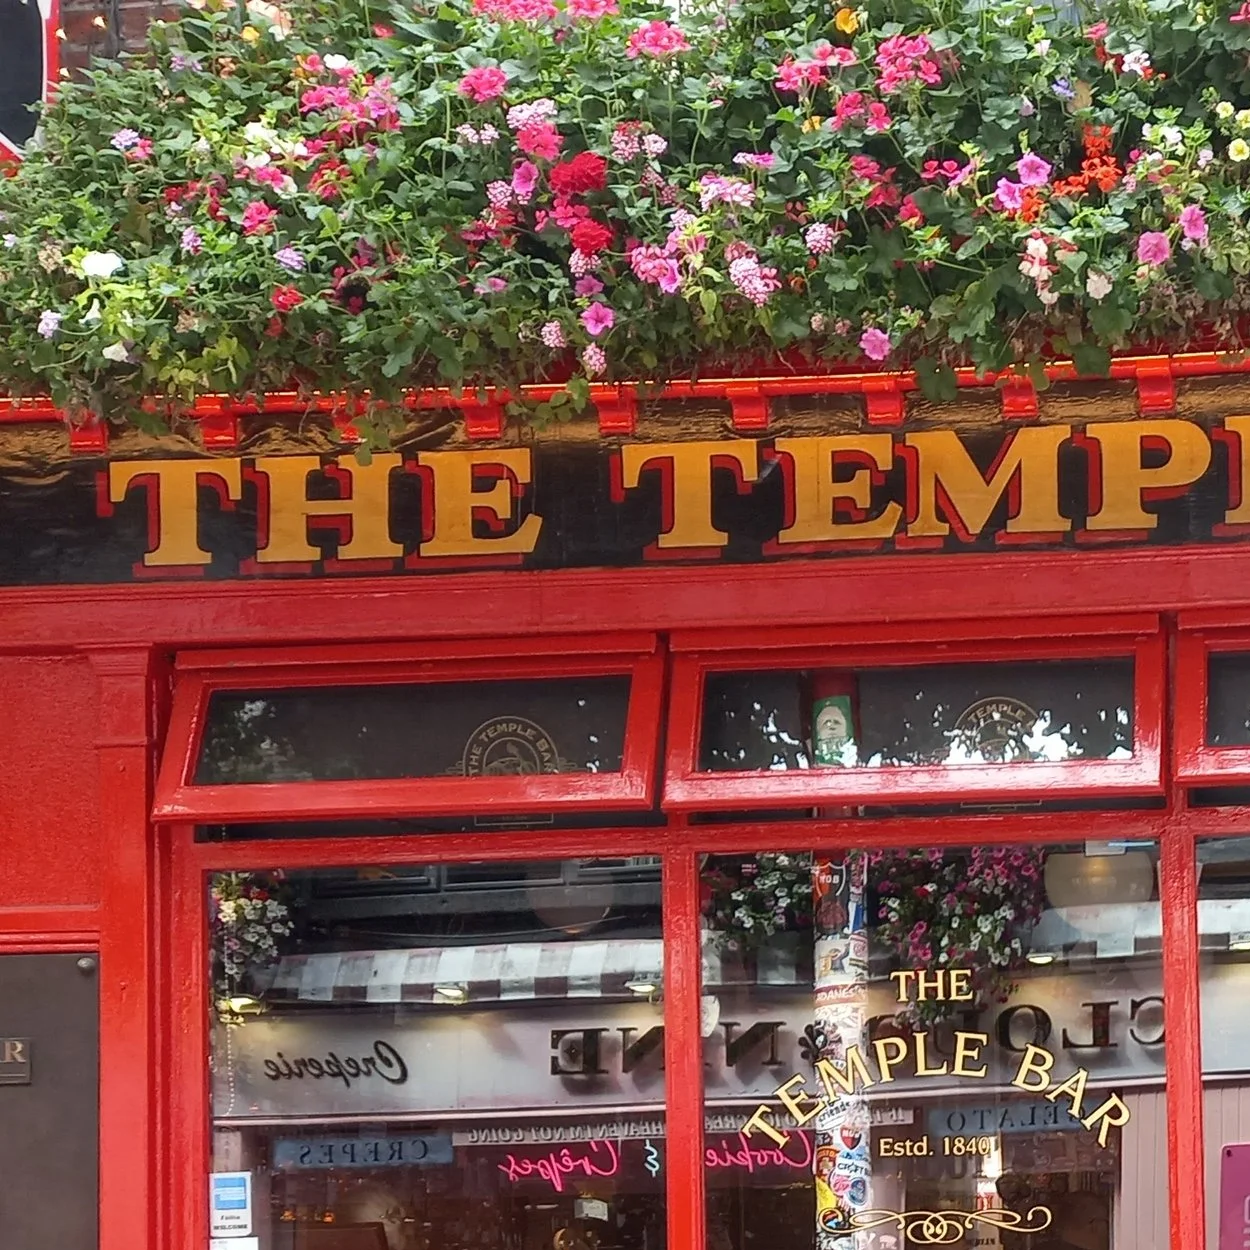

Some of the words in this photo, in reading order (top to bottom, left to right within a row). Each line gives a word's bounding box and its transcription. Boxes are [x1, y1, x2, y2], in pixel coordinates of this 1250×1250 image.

[98, 445, 543, 576] THE
[967, 703, 1027, 725] TEMPLE
[468, 744, 483, 775] THE
[479, 723, 537, 742] TEMPLE
[890, 968, 973, 1003] THE
[742, 1031, 989, 1150] TEMPLE
[1011, 1043, 1131, 1148] BAR
[879, 1137, 935, 1157] Estd.
[943, 1136, 991, 1156] 1840
